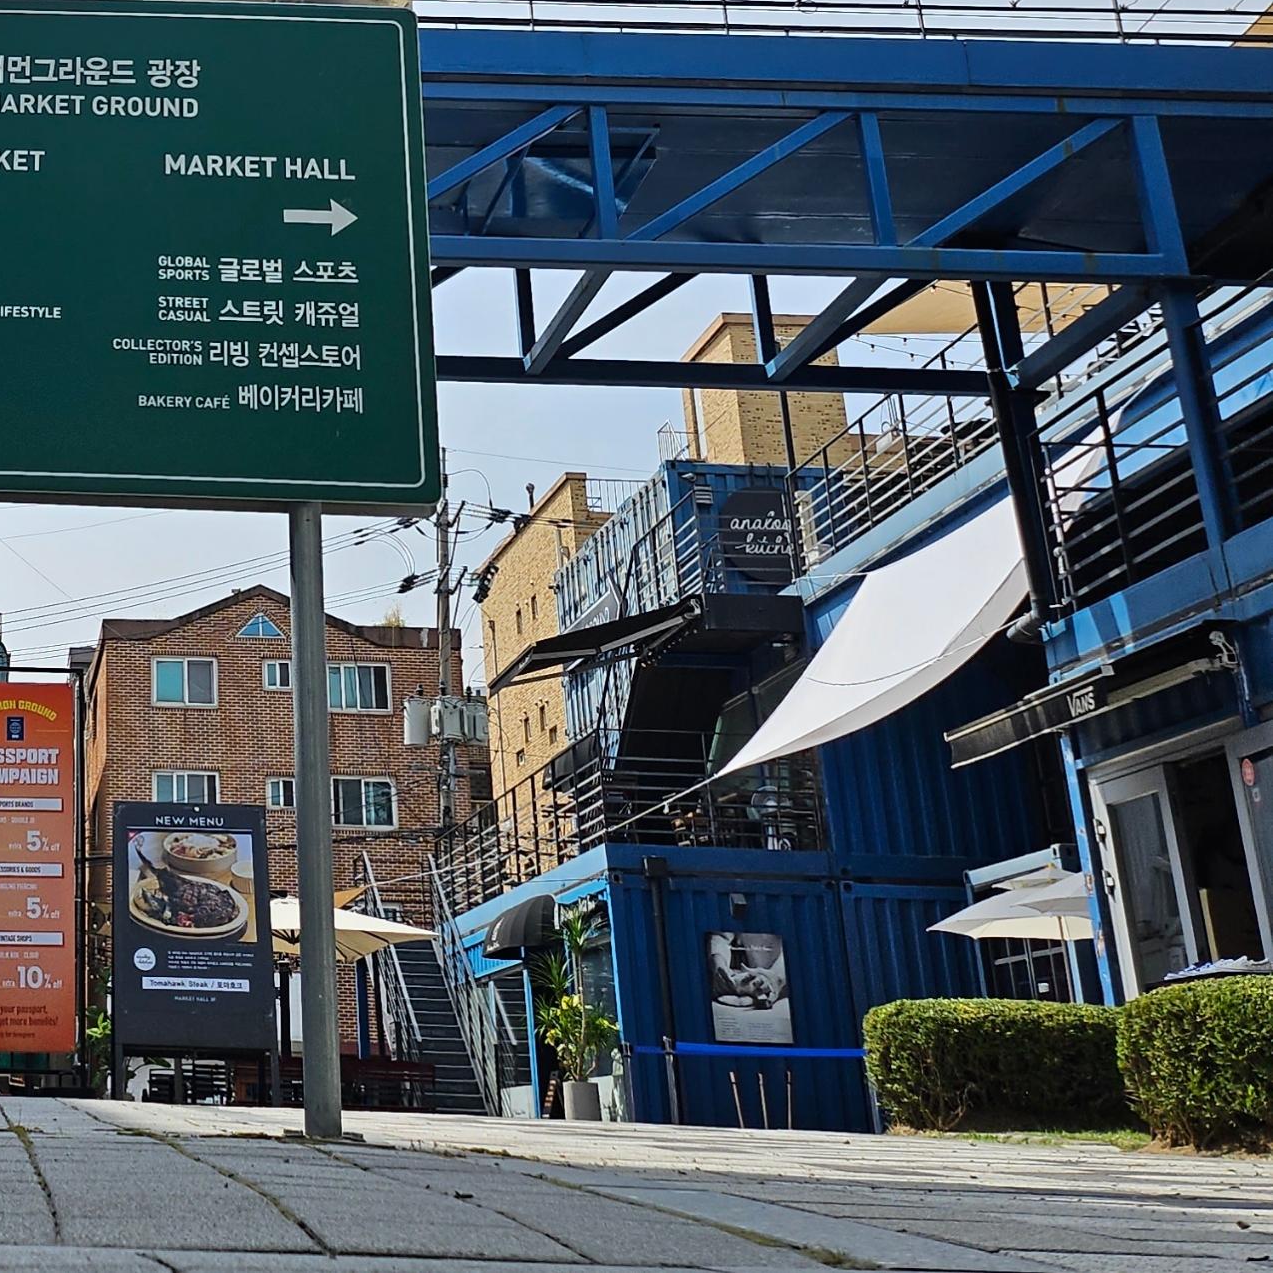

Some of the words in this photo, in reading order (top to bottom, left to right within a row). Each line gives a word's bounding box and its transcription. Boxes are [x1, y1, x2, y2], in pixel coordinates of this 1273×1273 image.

[147, 59, 201, 88] 광장
[91, 95, 199, 118] GROUND
[164, 154, 277, 178] MARKET
[285, 157, 356, 180] HALL
[158, 255, 210, 268] GLOBAL
[218, 257, 283, 283] 글로벌
[292, 260, 359, 283] 스포츠
[158, 269, 210, 281] SPORTS
[158, 296, 209, 309] STREET
[218, 299, 284, 326] 스트릿
[294, 300, 360, 328] 캐쥬얼
[158, 310, 211, 323] CASUAL
[113, 338, 203, 352] COLLECTOR'S
[209, 340, 249, 367] 리빙
[258, 341, 361, 371] 컨셉스토어
[149, 352, 203, 366] EDITION
[138, 395, 192, 408] BAKERY
[195, 395, 231, 410] CAFÉ
[238, 384, 364, 415] 베이커리카페
[18, 699, 58, 722] GROUND
[1067, 685, 1095, 717] VANS
[155, 815, 185, 827] NEW
[189, 816, 225, 827] MENU
[149, 979, 185, 987] Tomahawk
[189, 980, 208, 988] Steak
